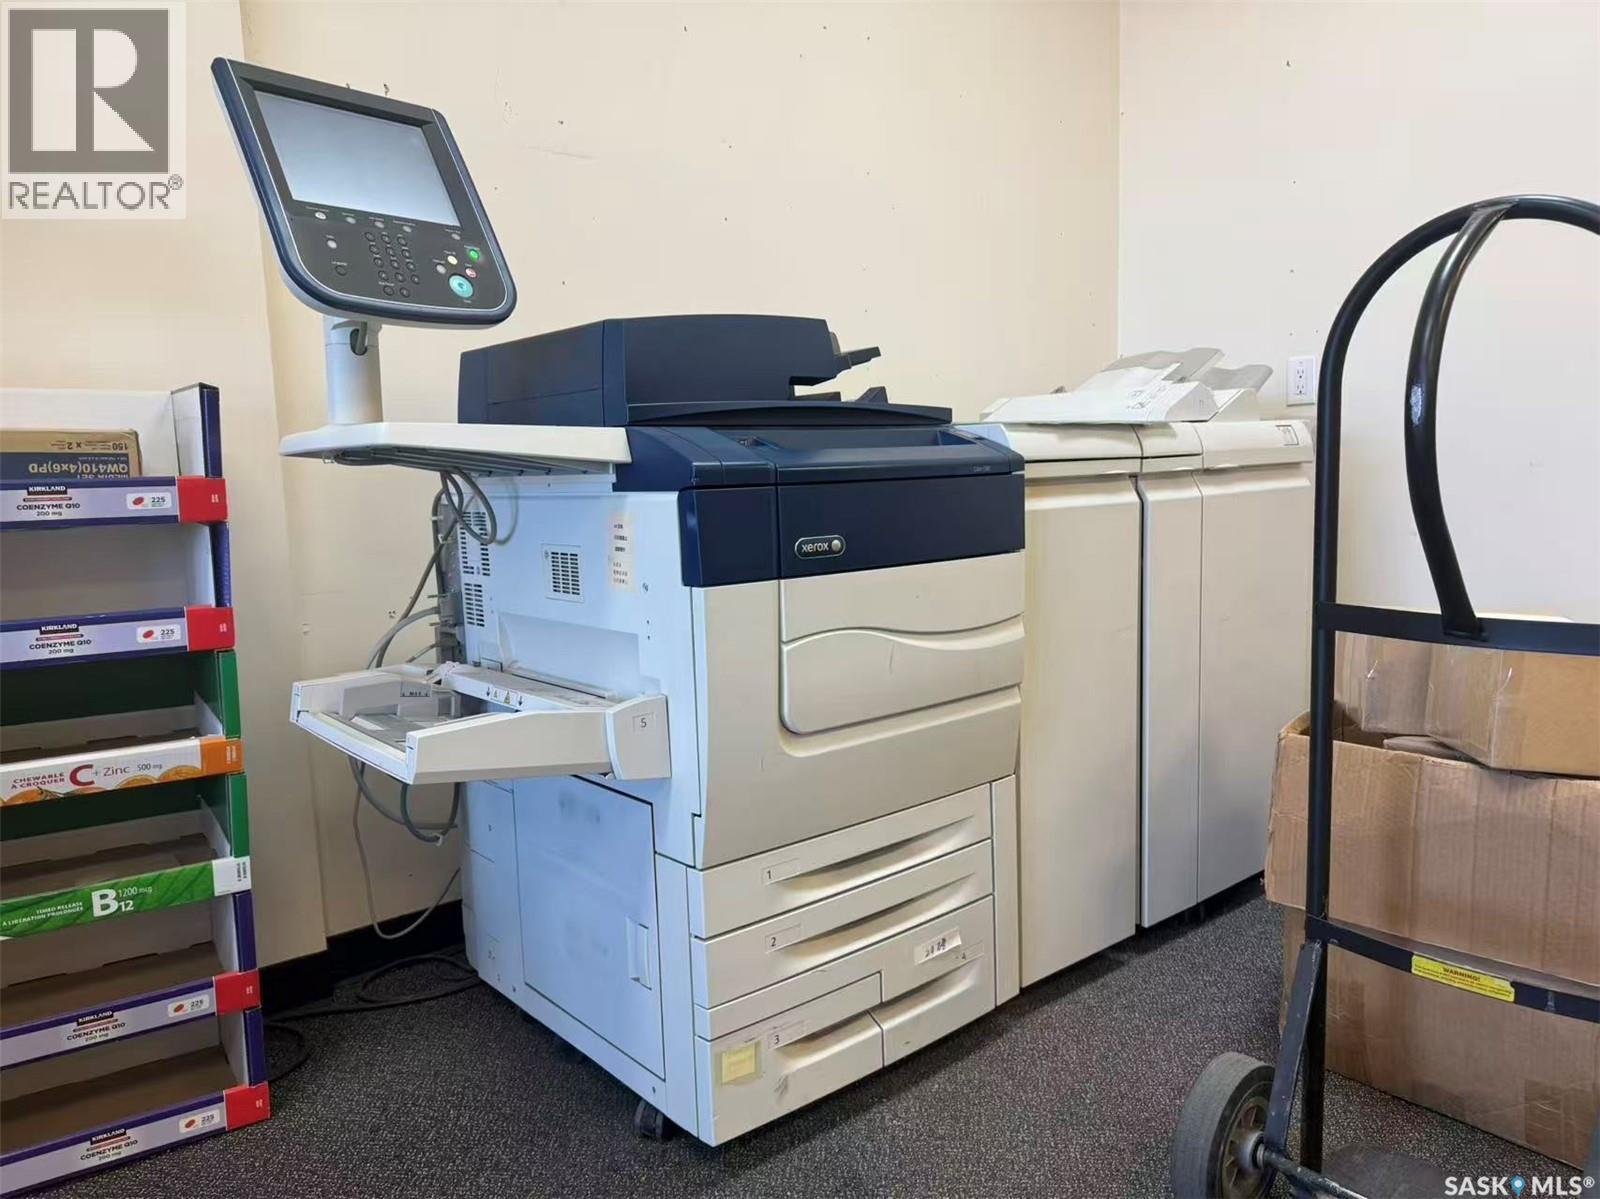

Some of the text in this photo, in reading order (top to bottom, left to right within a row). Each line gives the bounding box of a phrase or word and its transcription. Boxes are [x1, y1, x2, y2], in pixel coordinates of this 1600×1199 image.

[66, 441, 73, 450] 2
[112, 442, 128, 451] 150
[28, 461, 128, 473] QW410(4x6)PD
[28, 485, 66, 493] KIRKLAND
[17, 503, 64, 511] COENZYME
[801, 541, 829, 553] xerox
[41, 623, 77, 632] KIRKLAND
[160, 628, 175, 636] 225
[29, 640, 75, 650] COENZYME
[640, 716, 647, 728] 5
[13, 772, 64, 783] CHEWABLE
[69, 764, 95, 787] C
[104, 765, 130, 777] Zinc
[137, 763, 151, 772] 500
[19, 777, 65, 789] CROQUER
[767, 870, 772, 880] 1
[118, 886, 138, 897] 1200
[770, 937, 777, 947] 2
[1442, 967, 1480, 982] WARNING!
[66, 1026, 110, 1041] COENZYME
[111, 1022, 126, 1030] Q10
[774, 1034, 780, 1044] 3
[80, 1144, 123, 1160] COENZYME
